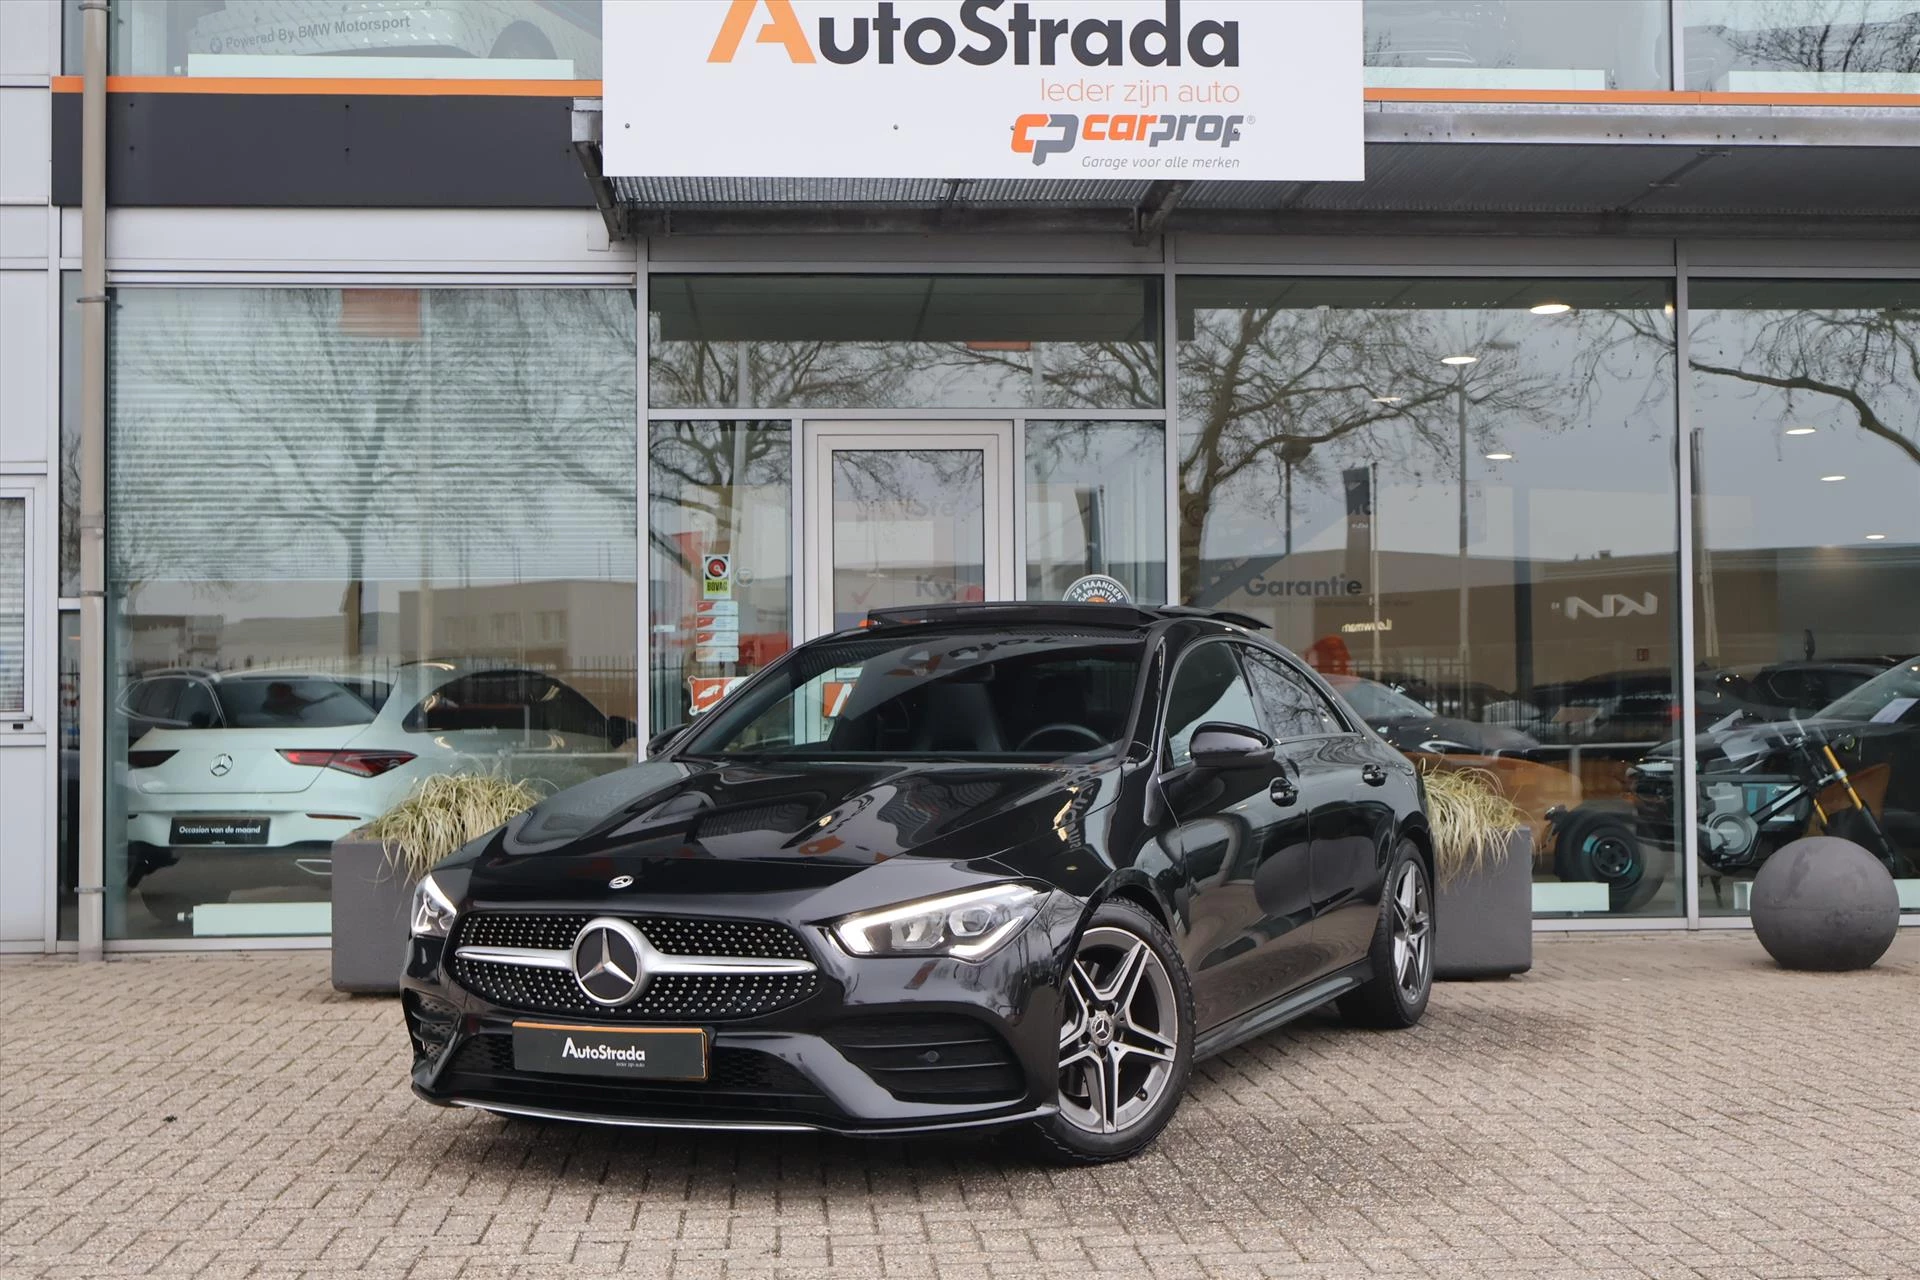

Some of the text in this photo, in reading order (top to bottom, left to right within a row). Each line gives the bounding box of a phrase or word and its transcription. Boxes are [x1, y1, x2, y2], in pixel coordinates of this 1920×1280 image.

[225, 16, 411, 49] Powered By BMW Motorsport
[706, 0, 1240, 67] AutoStrada
[1041, 78, 1240, 108] Ieder zijn auto
[1082, 155, 1240, 170] Garage voor alle merken
[1082, 580, 1124, 600] MAANDEN
[1245, 573, 1362, 596] Garantie
[179, 825, 210, 834] Occasion
[225, 825, 235, 834] de
[235, 825, 261, 834] maand
[562, 1037, 646, 1061] AutoStrada
